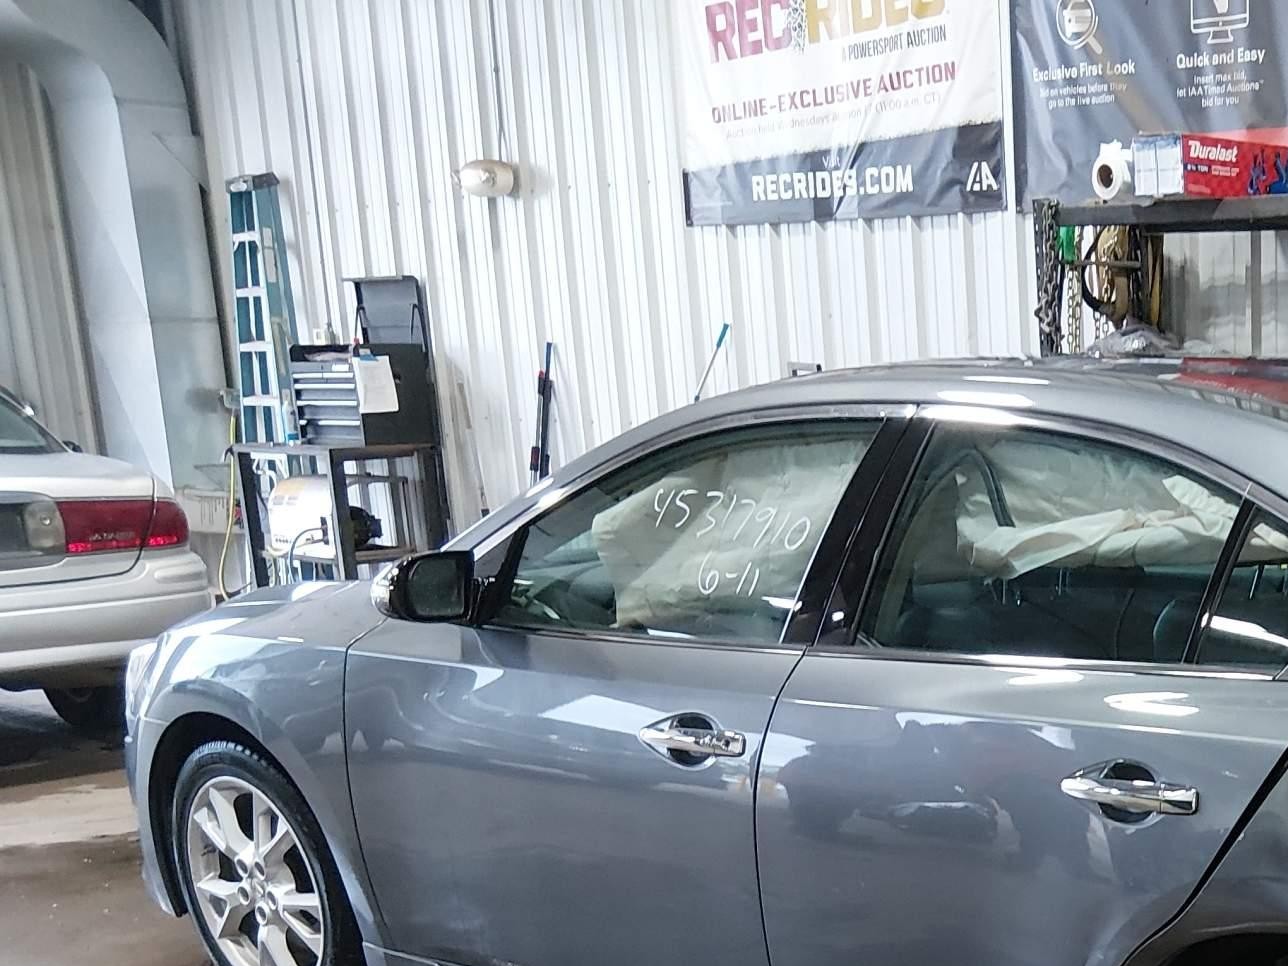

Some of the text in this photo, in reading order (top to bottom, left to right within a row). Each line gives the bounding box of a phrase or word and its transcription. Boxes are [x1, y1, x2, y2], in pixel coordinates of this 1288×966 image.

[848, 32, 903, 61] POWERSPORT
[906, 24, 947, 48] AUCTION
[1176, 47, 1265, 69] Quick and Easy
[1032, 58, 1135, 82] Exclusive First Look
[1215, 73, 1231, 82] max
[711, 78, 872, 124] ONLINE-EXCLUSIVE
[877, 61, 956, 93] AUCTION
[1060, 84, 1087, 96] vehicles
[1087, 82, 1108, 94] before
[1065, 97, 1076, 106] the
[1077, 95, 1090, 106] live
[1091, 93, 1115, 105] auction
[1201, 95, 1239, 108] bid for you
[1188, 140, 1238, 163] Duralast
[752, 165, 913, 201] RECRIDES.COM
[653, 488, 811, 551] 45317910
[697, 550, 760, 597] 6-11
